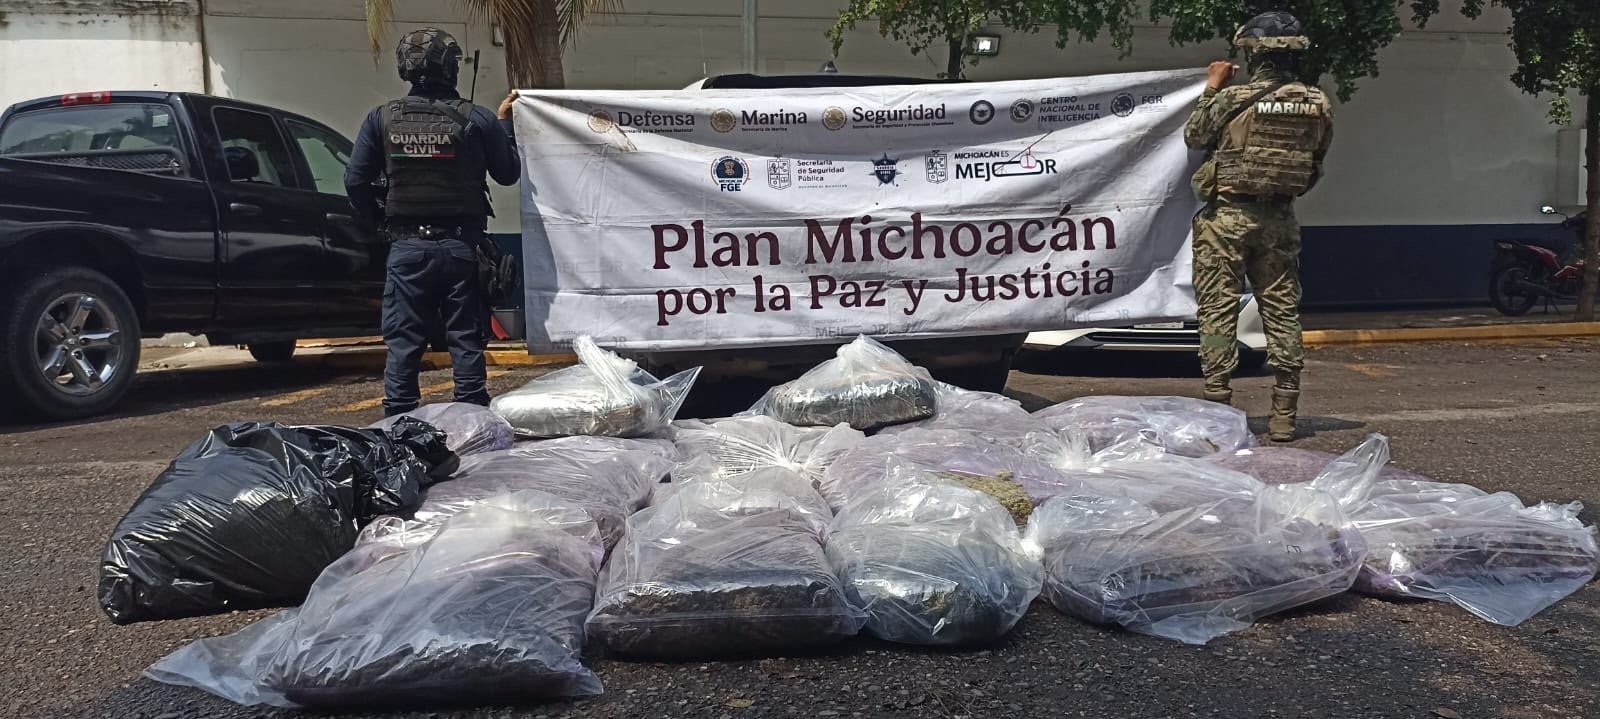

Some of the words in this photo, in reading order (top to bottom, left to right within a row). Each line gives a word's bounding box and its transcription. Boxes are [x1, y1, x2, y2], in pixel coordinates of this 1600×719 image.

[1041, 96, 1077, 105] CENTRO
[1141, 96, 1163, 104] FGR
[852, 103, 946, 124] Seguridad
[1039, 105, 1085, 113] NACIONAL
[1257, 102, 1318, 114] MARINA
[618, 110, 695, 126] Defensa
[741, 109, 807, 125] Marina
[1038, 113, 1100, 122] INTELIGENCIA
[390, 134, 452, 145] GUARDIA
[403, 144, 440, 154] CIVIL
[954, 151, 999, 159] MICHOACÁN
[955, 159, 1057, 182] MEJOR
[720, 183, 741, 192] FGE
[651, 219, 780, 270] Plan
[804, 204, 1117, 265] Michoacán
[655, 286, 736, 326] por
[753, 274, 792, 312] la
[808, 274, 887, 310] Paz
[903, 279, 929, 316] y
[944, 260, 1115, 303] Justicia
